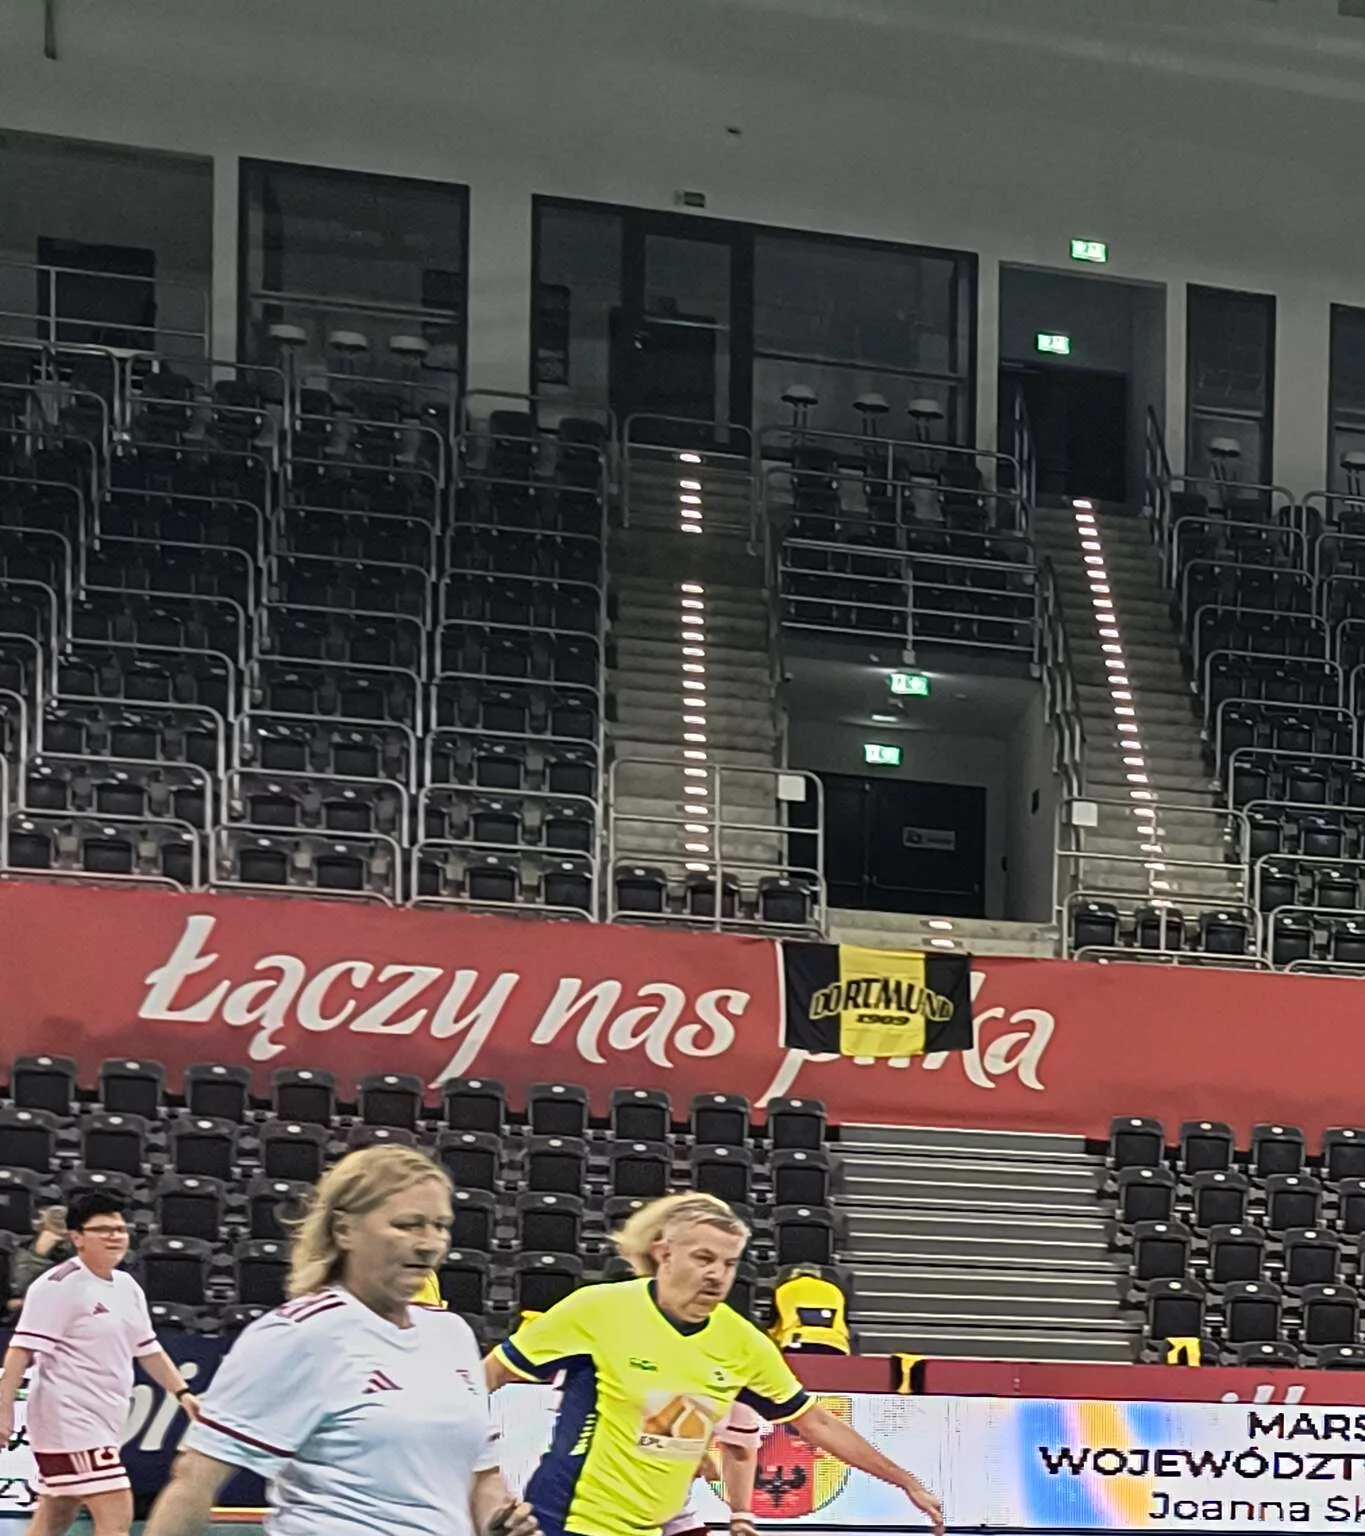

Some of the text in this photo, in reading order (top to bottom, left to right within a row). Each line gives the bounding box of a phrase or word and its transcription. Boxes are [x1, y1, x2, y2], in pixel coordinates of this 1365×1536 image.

[138, 914, 520, 1090] Łączy
[531, 976, 751, 1069] nas
[809, 974, 954, 1022] DORTMUND
[855, 1014, 911, 1026] 1909
[1149, 1491, 1310, 1523] Joanna
